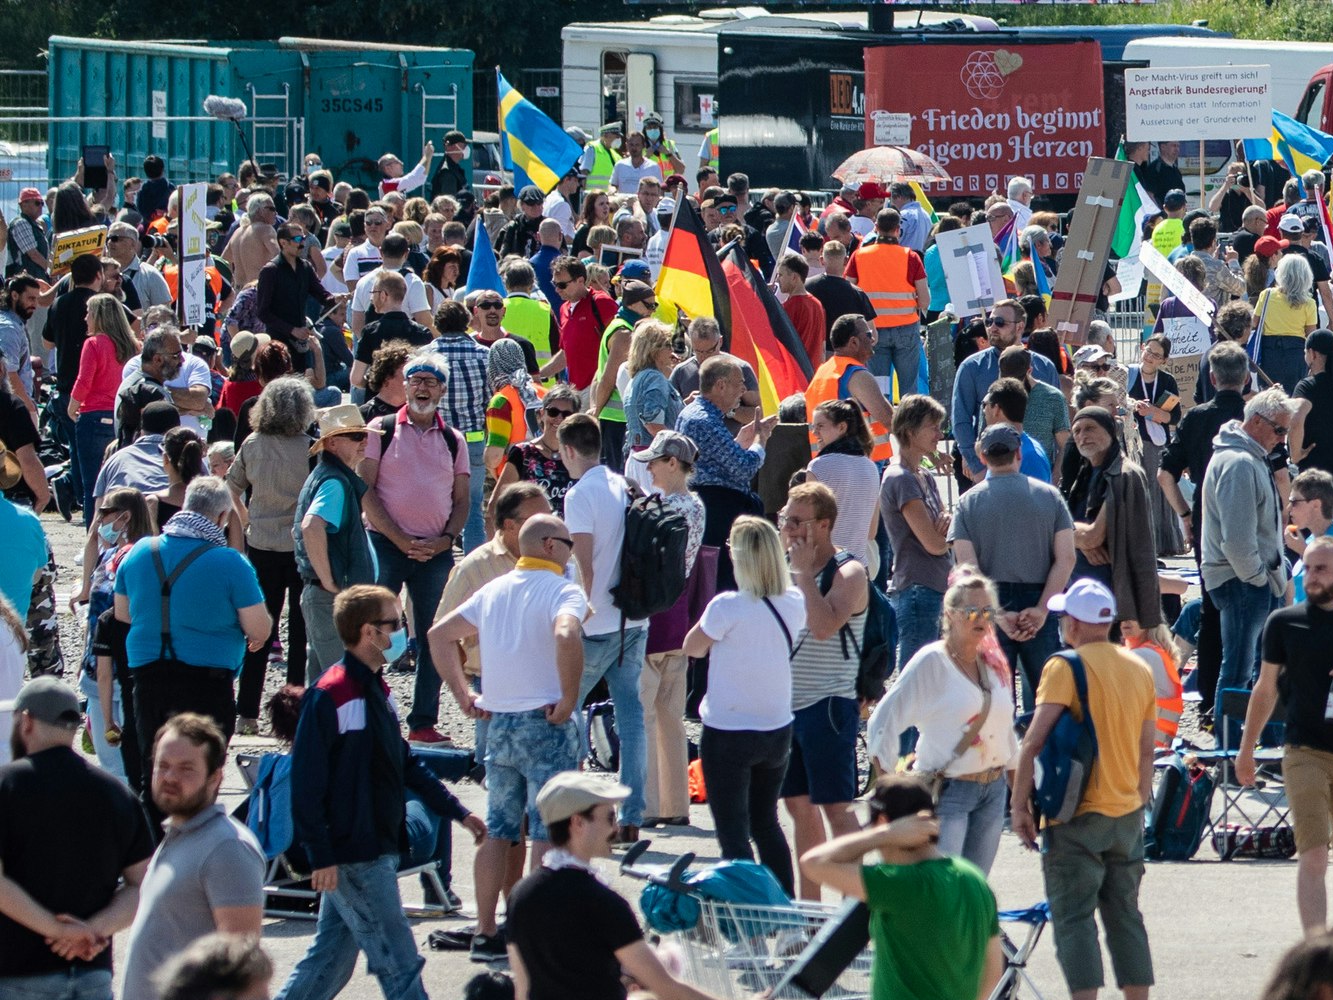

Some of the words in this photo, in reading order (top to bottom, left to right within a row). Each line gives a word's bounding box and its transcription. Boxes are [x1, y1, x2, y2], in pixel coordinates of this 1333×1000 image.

[1135, 74, 1148, 82] Der
[1151, 73, 1199, 81] Macht-Virus
[1201, 72, 1222, 81] greift
[1240, 71, 1259, 80] sich!
[1129, 86, 1183, 97] Angstfabrik
[1185, 84, 1267, 95] Bundesregierung!
[321, 99, 384, 113] 35CS45
[1135, 102, 1186, 111] Manipulation
[1189, 101, 1207, 109] statt
[1211, 100, 1261, 108] Information!
[922, 107, 1011, 131] Frieden
[1015, 105, 1102, 134] beginnt
[1140, 118, 1184, 126] Aussetzung
[1203, 115, 1257, 124] Grundrechte!
[916, 138, 1002, 167] eigenen
[1008, 131, 1094, 163] Herzen
[57, 237, 98, 252] DIKTATUR
